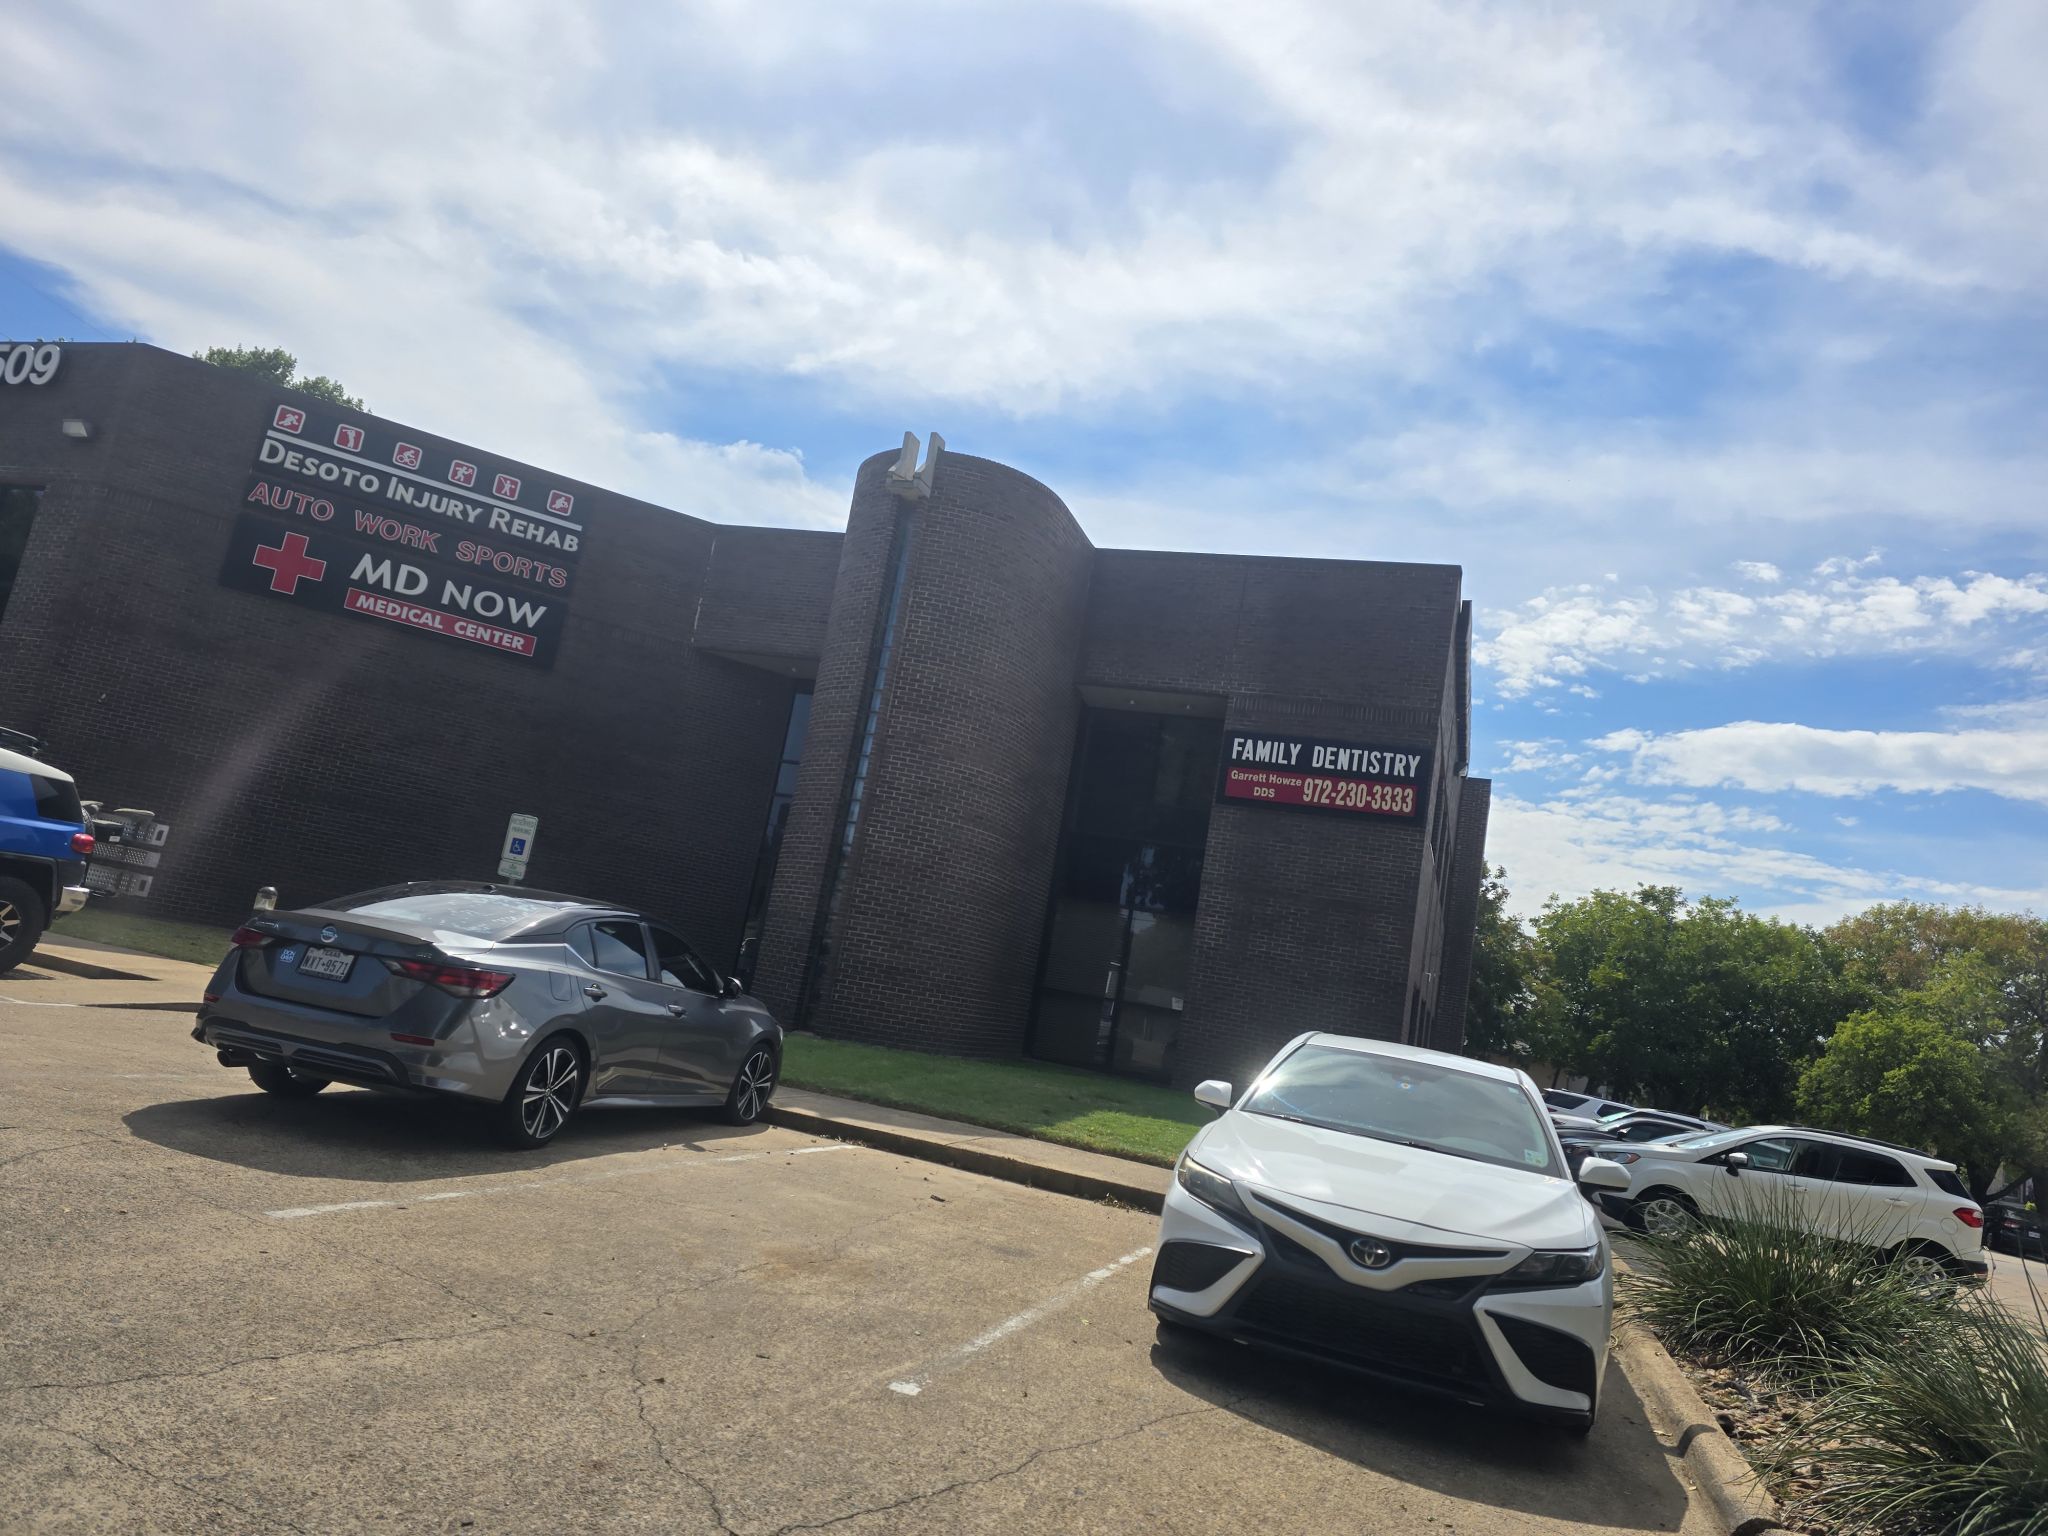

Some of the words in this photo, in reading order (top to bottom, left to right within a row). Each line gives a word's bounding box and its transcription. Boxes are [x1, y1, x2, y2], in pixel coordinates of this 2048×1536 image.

[258, 438, 380, 493] DESOTO
[386, 476, 484, 524] INJURY
[488, 507, 579, 552] REHAB
[247, 481, 335, 522] AUTO
[354, 509, 442, 553] WORK
[455, 540, 568, 588] SPORTS
[350, 553, 429, 596] MD
[440, 580, 548, 629] NOW
[355, 594, 444, 630] MEDICAL
[454, 621, 526, 650] CENTER
[1231, 737, 1302, 766] FAMILY
[1312, 745, 1421, 778] DENTISTRY
[1231, 770, 1267, 783] Garrett
[1269, 774, 1302, 786] Howze
[1253, 786, 1275, 798] DDS
[1302, 778, 1413, 813] 972-230-3333
